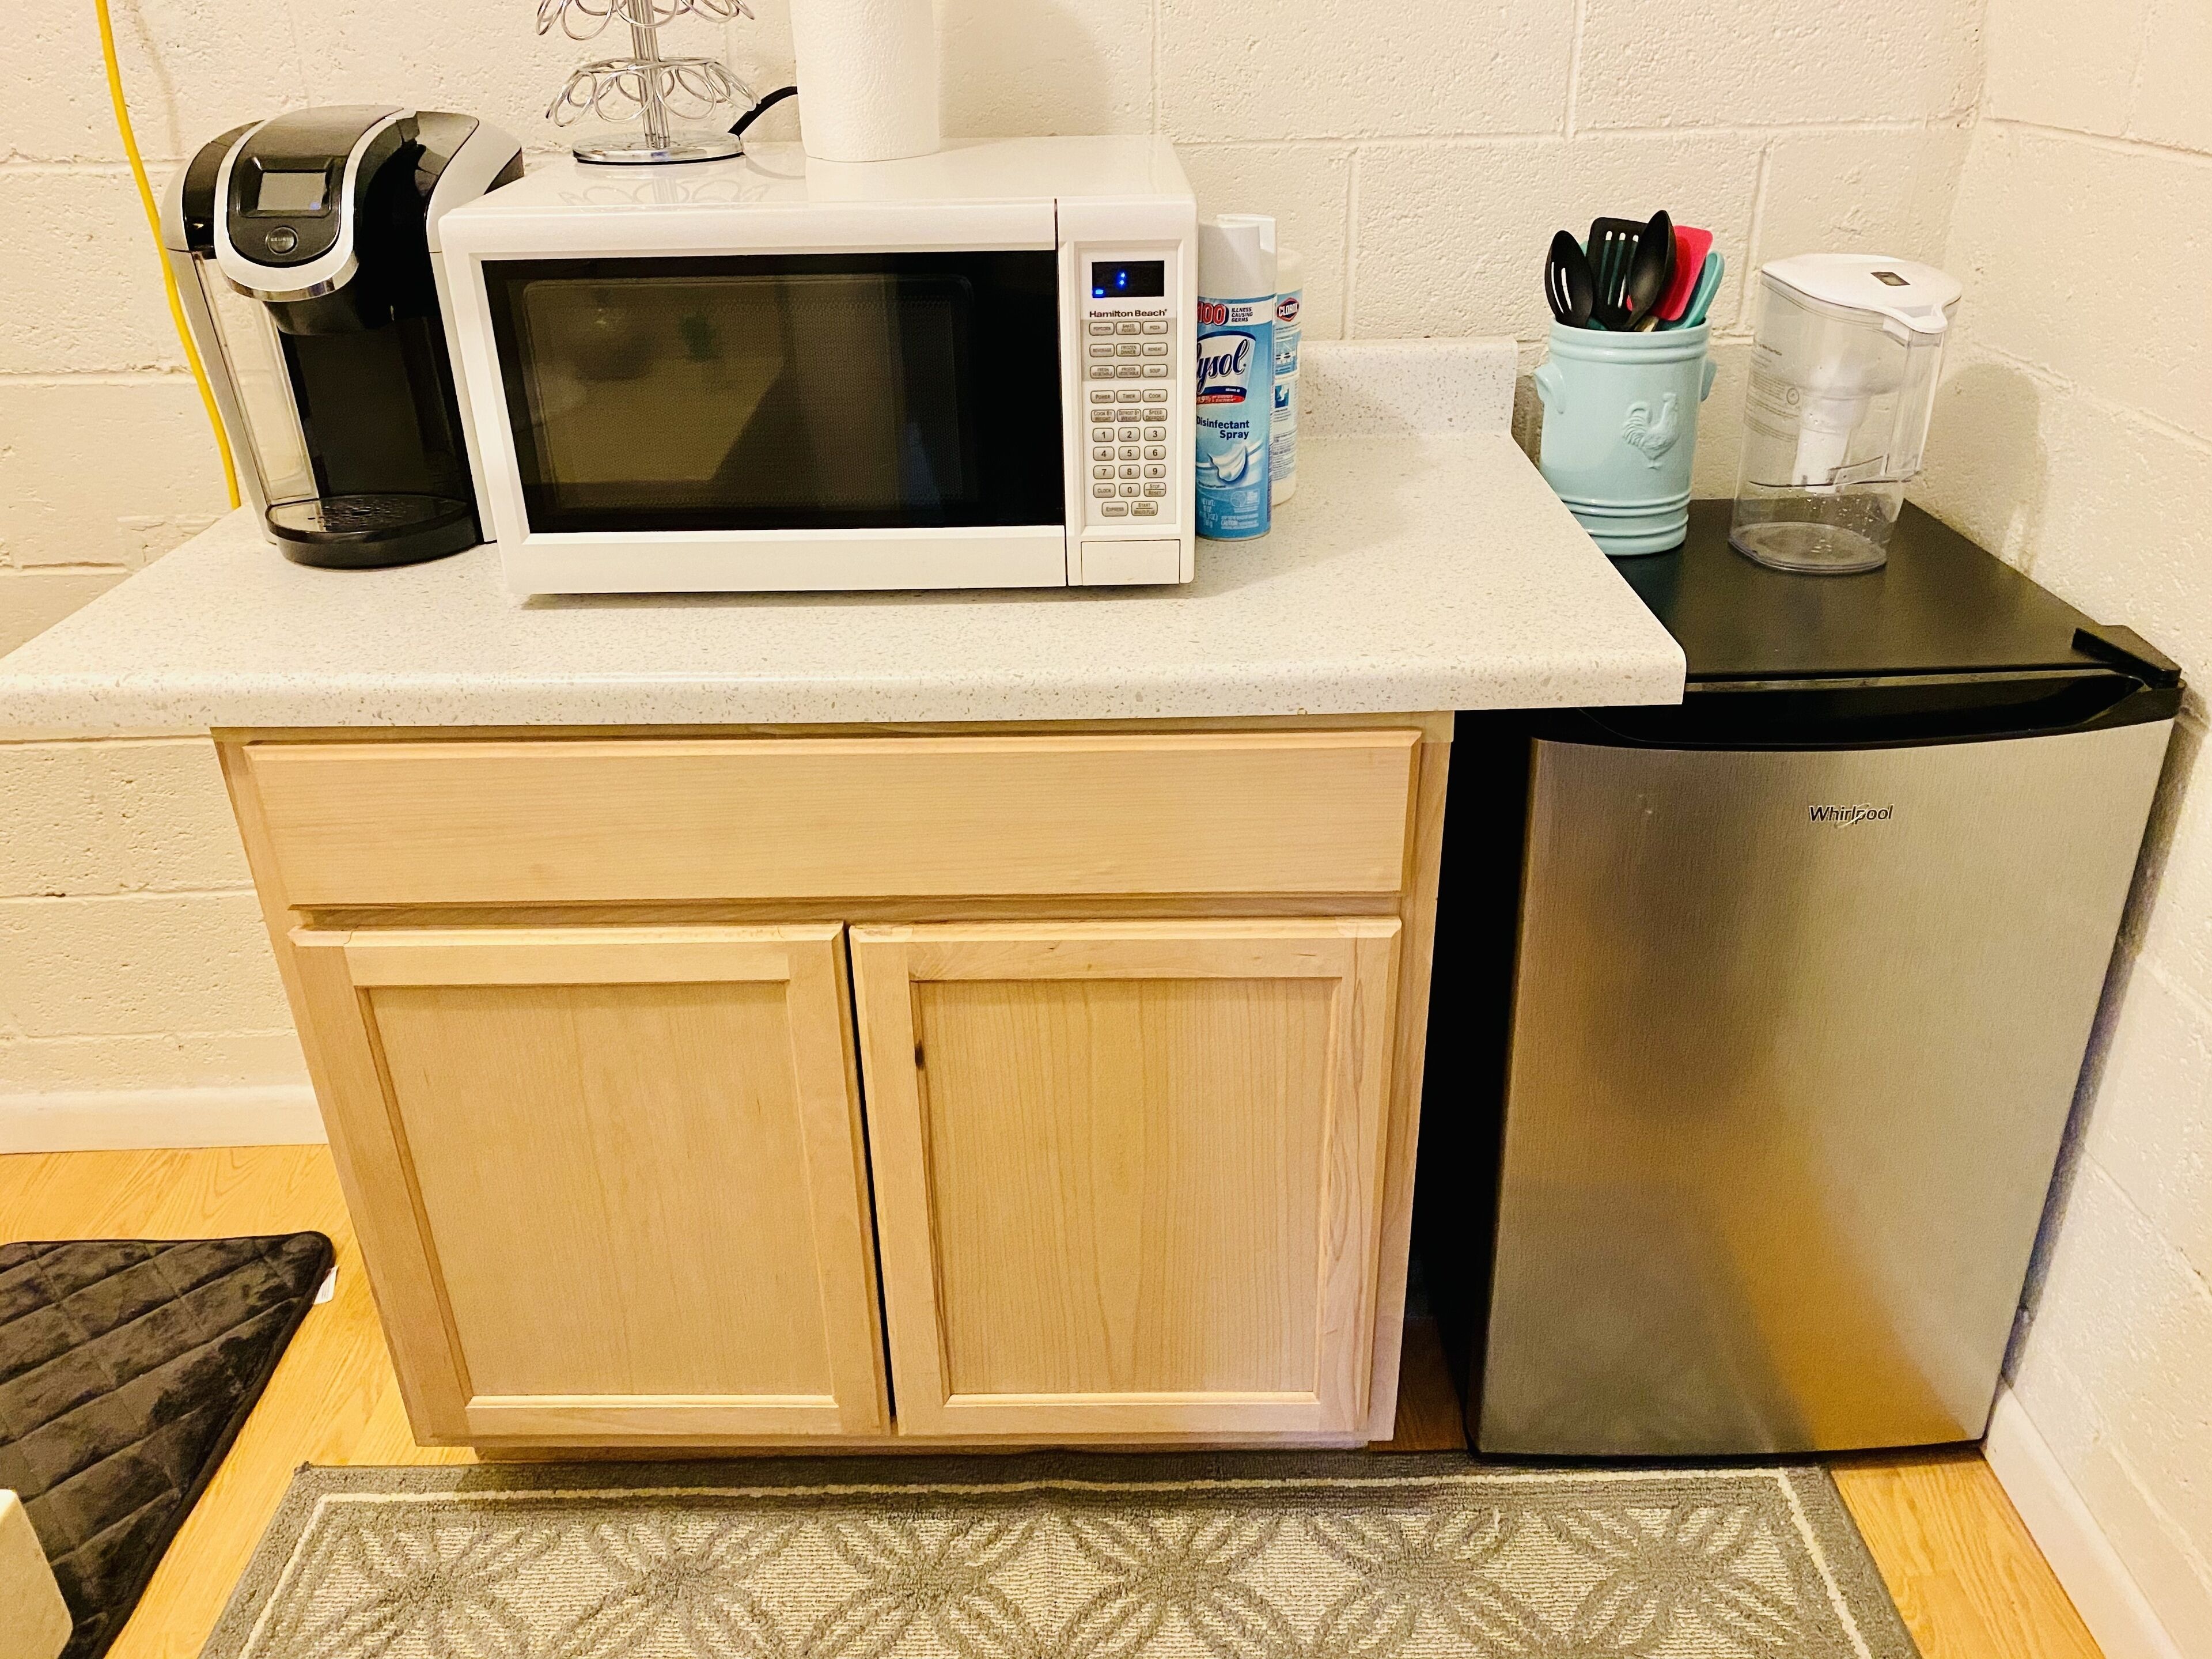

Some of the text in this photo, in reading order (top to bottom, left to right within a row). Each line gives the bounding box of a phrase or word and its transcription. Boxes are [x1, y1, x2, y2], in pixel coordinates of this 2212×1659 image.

[1197, 339, 1249, 395] ysol
[1196, 415, 1249, 429] Disinfectant
[1219, 430, 1249, 440] Spray
[1809, 804, 1894, 825] Whirlpool
